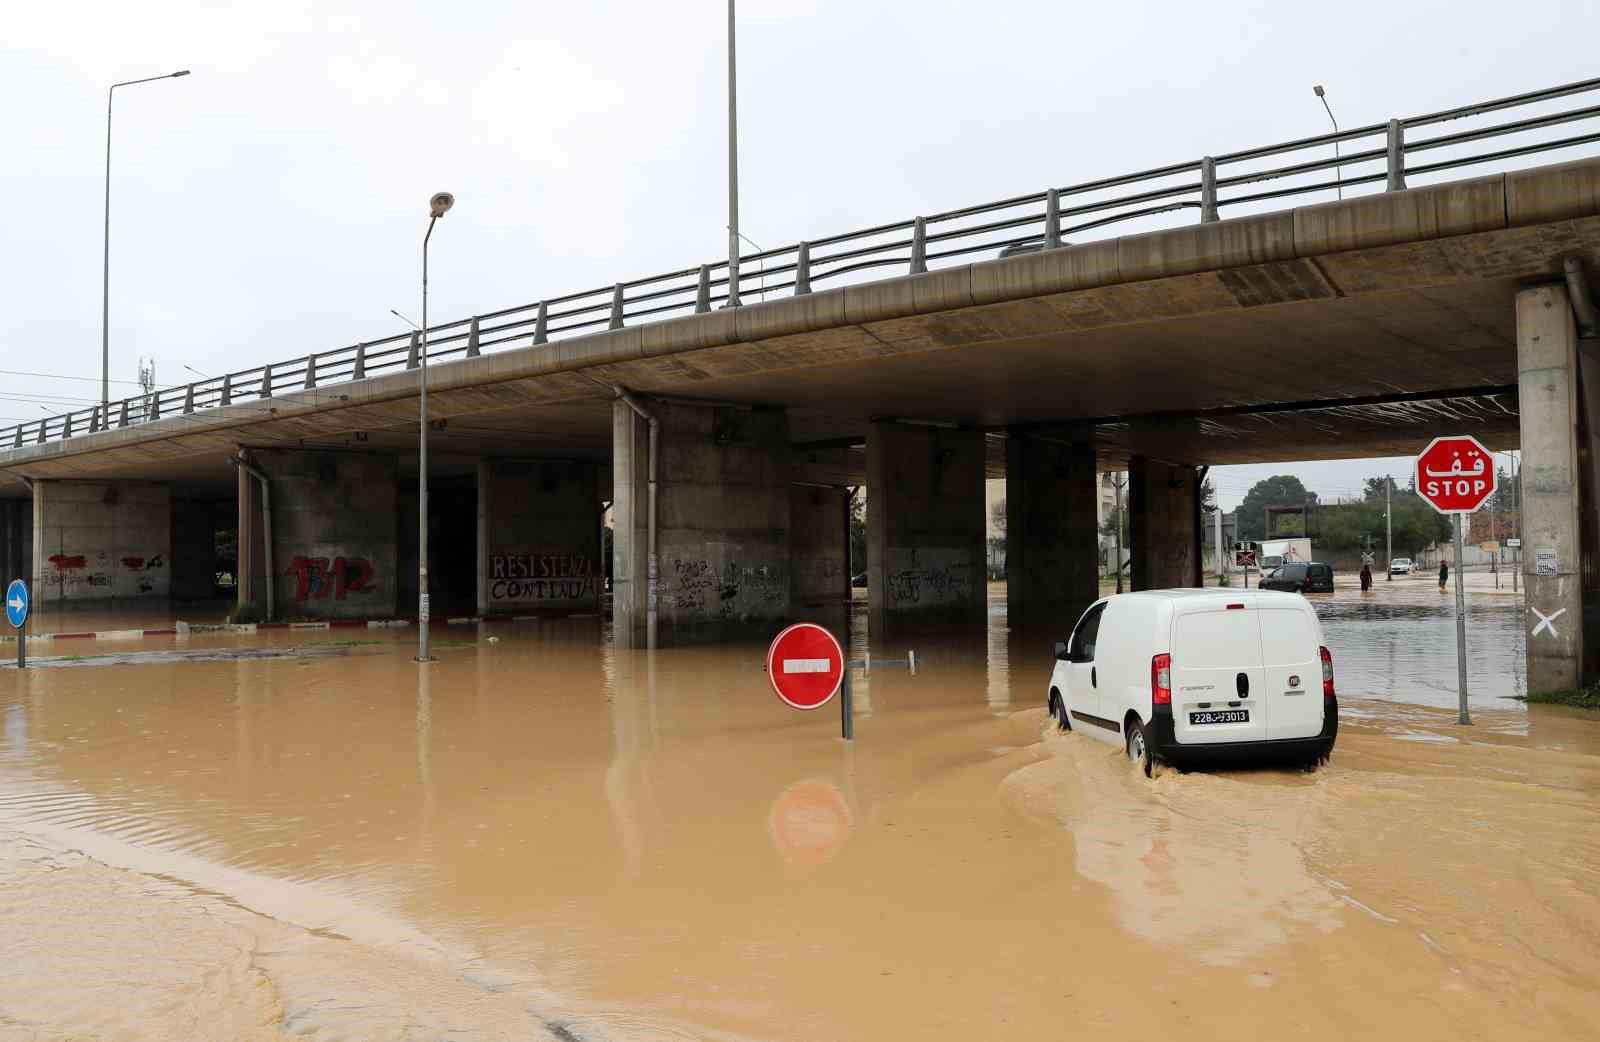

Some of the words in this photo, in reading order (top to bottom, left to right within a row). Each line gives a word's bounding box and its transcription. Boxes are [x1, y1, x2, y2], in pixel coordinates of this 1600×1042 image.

[1426, 450, 1485, 477] قف
[1426, 480, 1486, 497] STOP
[491, 578, 594, 600] CONTINUA
[1194, 713, 1211, 723] 228
[1225, 711, 1245, 721] 3013
